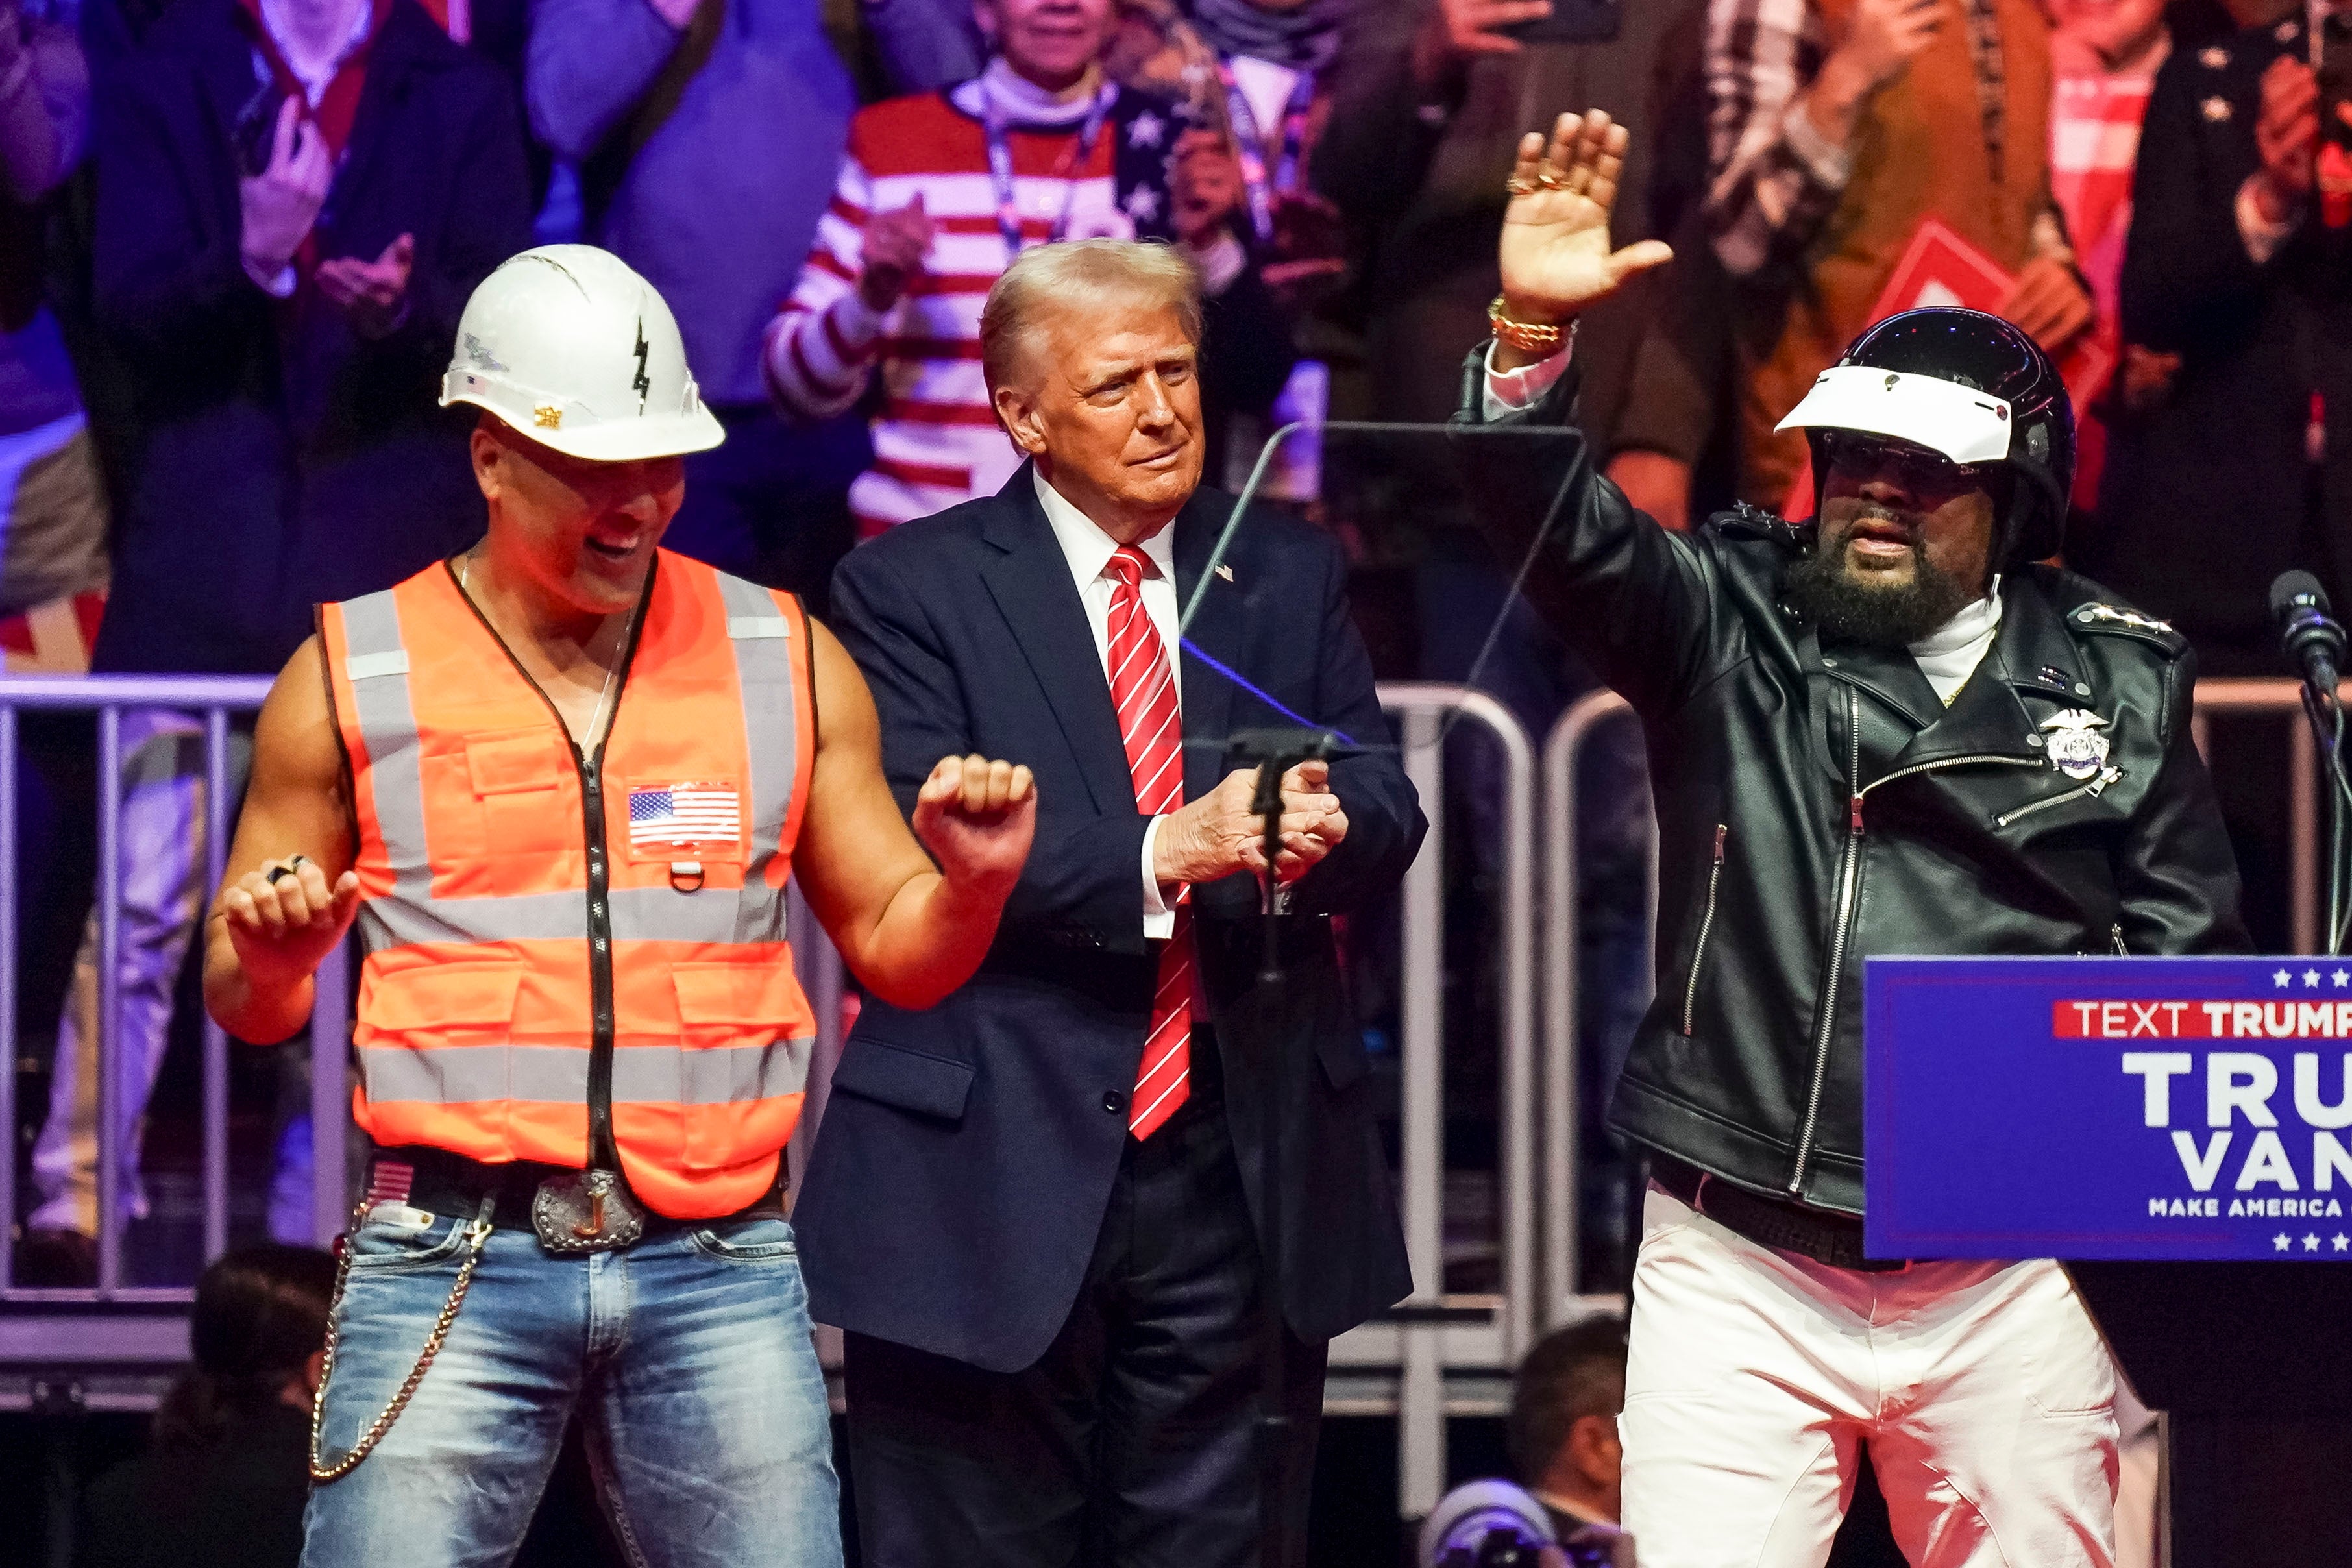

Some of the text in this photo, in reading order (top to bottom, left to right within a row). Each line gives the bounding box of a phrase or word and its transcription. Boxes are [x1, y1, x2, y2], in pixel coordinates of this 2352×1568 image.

[2072, 1001, 2188, 1038] TEXT
[2122, 1051, 2352, 1129] TRU
[2170, 1130, 2352, 1192] VAN
[2148, 1198, 2342, 1217] MAKE AMERICA
